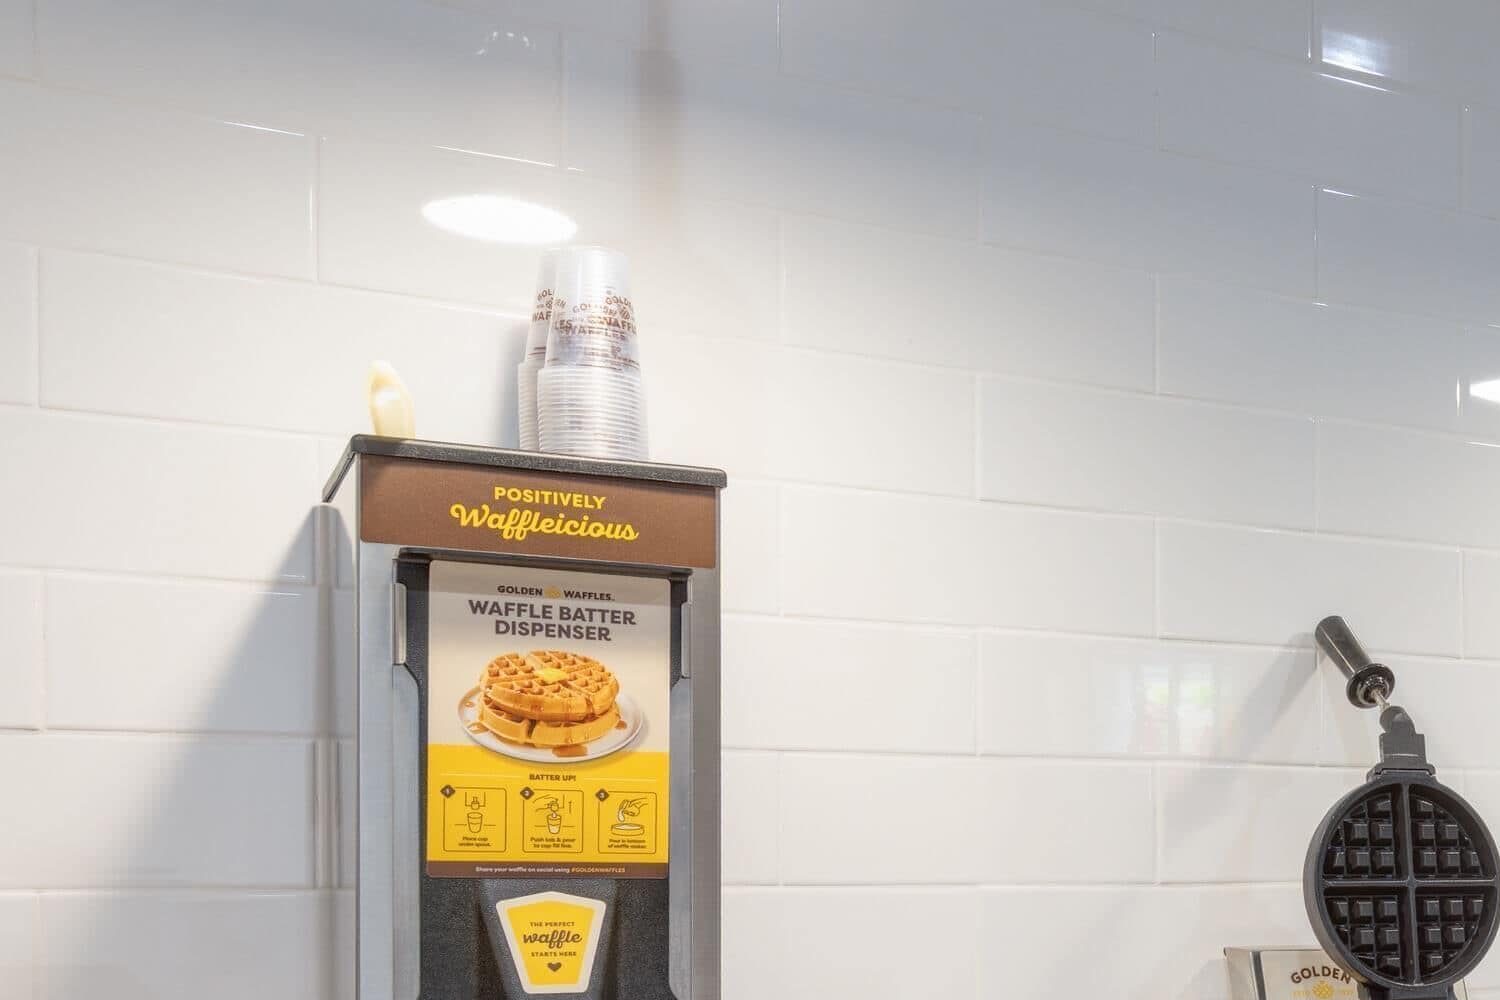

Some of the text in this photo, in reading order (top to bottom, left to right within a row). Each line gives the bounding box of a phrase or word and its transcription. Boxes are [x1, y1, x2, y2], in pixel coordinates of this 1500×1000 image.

[606, 295, 631, 306] GOLD
[494, 486, 607, 510] POSITIVELY
[450, 503, 640, 541] Waffleicious
[497, 585, 612, 601] GOLDEN WAFFLES
[468, 599, 637, 626] WAFFLE BATTER
[495, 619, 612, 641] DISPENSER
[562, 774, 577, 782] UP!
[523, 929, 583, 949] waffle
[1291, 965, 1351, 984] GOLDEN
